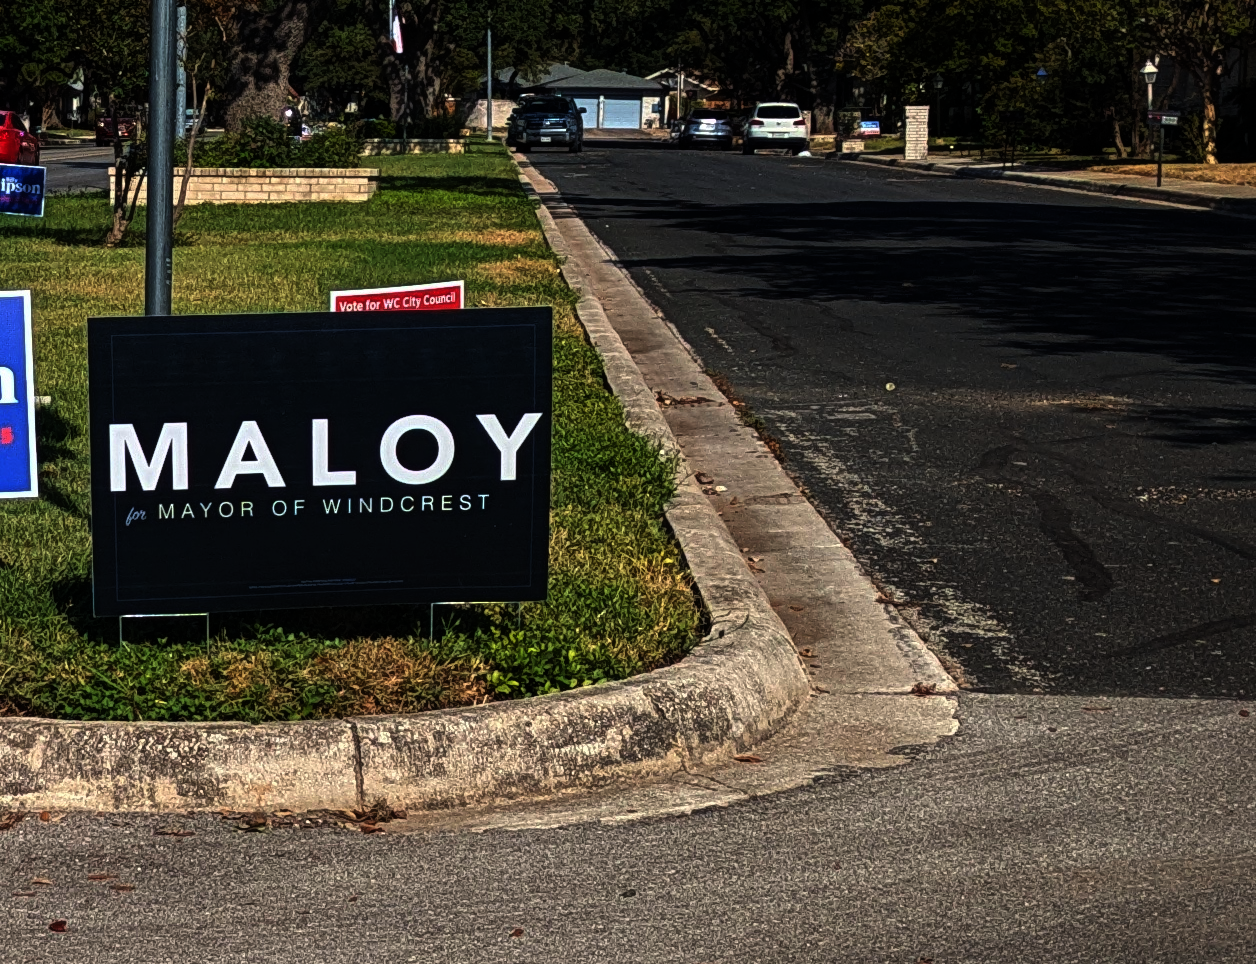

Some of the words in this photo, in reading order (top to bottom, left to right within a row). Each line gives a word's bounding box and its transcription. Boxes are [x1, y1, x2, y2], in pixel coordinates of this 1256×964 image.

[339, 300, 364, 311] Vote
[365, 299, 381, 310] for
[383, 297, 401, 309] WC
[402, 296, 421, 309] City
[423, 292, 455, 305] Council
[0, 426, 13, 445] 5
[108, 412, 543, 493] MALOY
[125, 506, 147, 526] for
[158, 501, 254, 520] MAYOR
[272, 499, 307, 517] OF
[322, 494, 490, 515] WINDCREST
